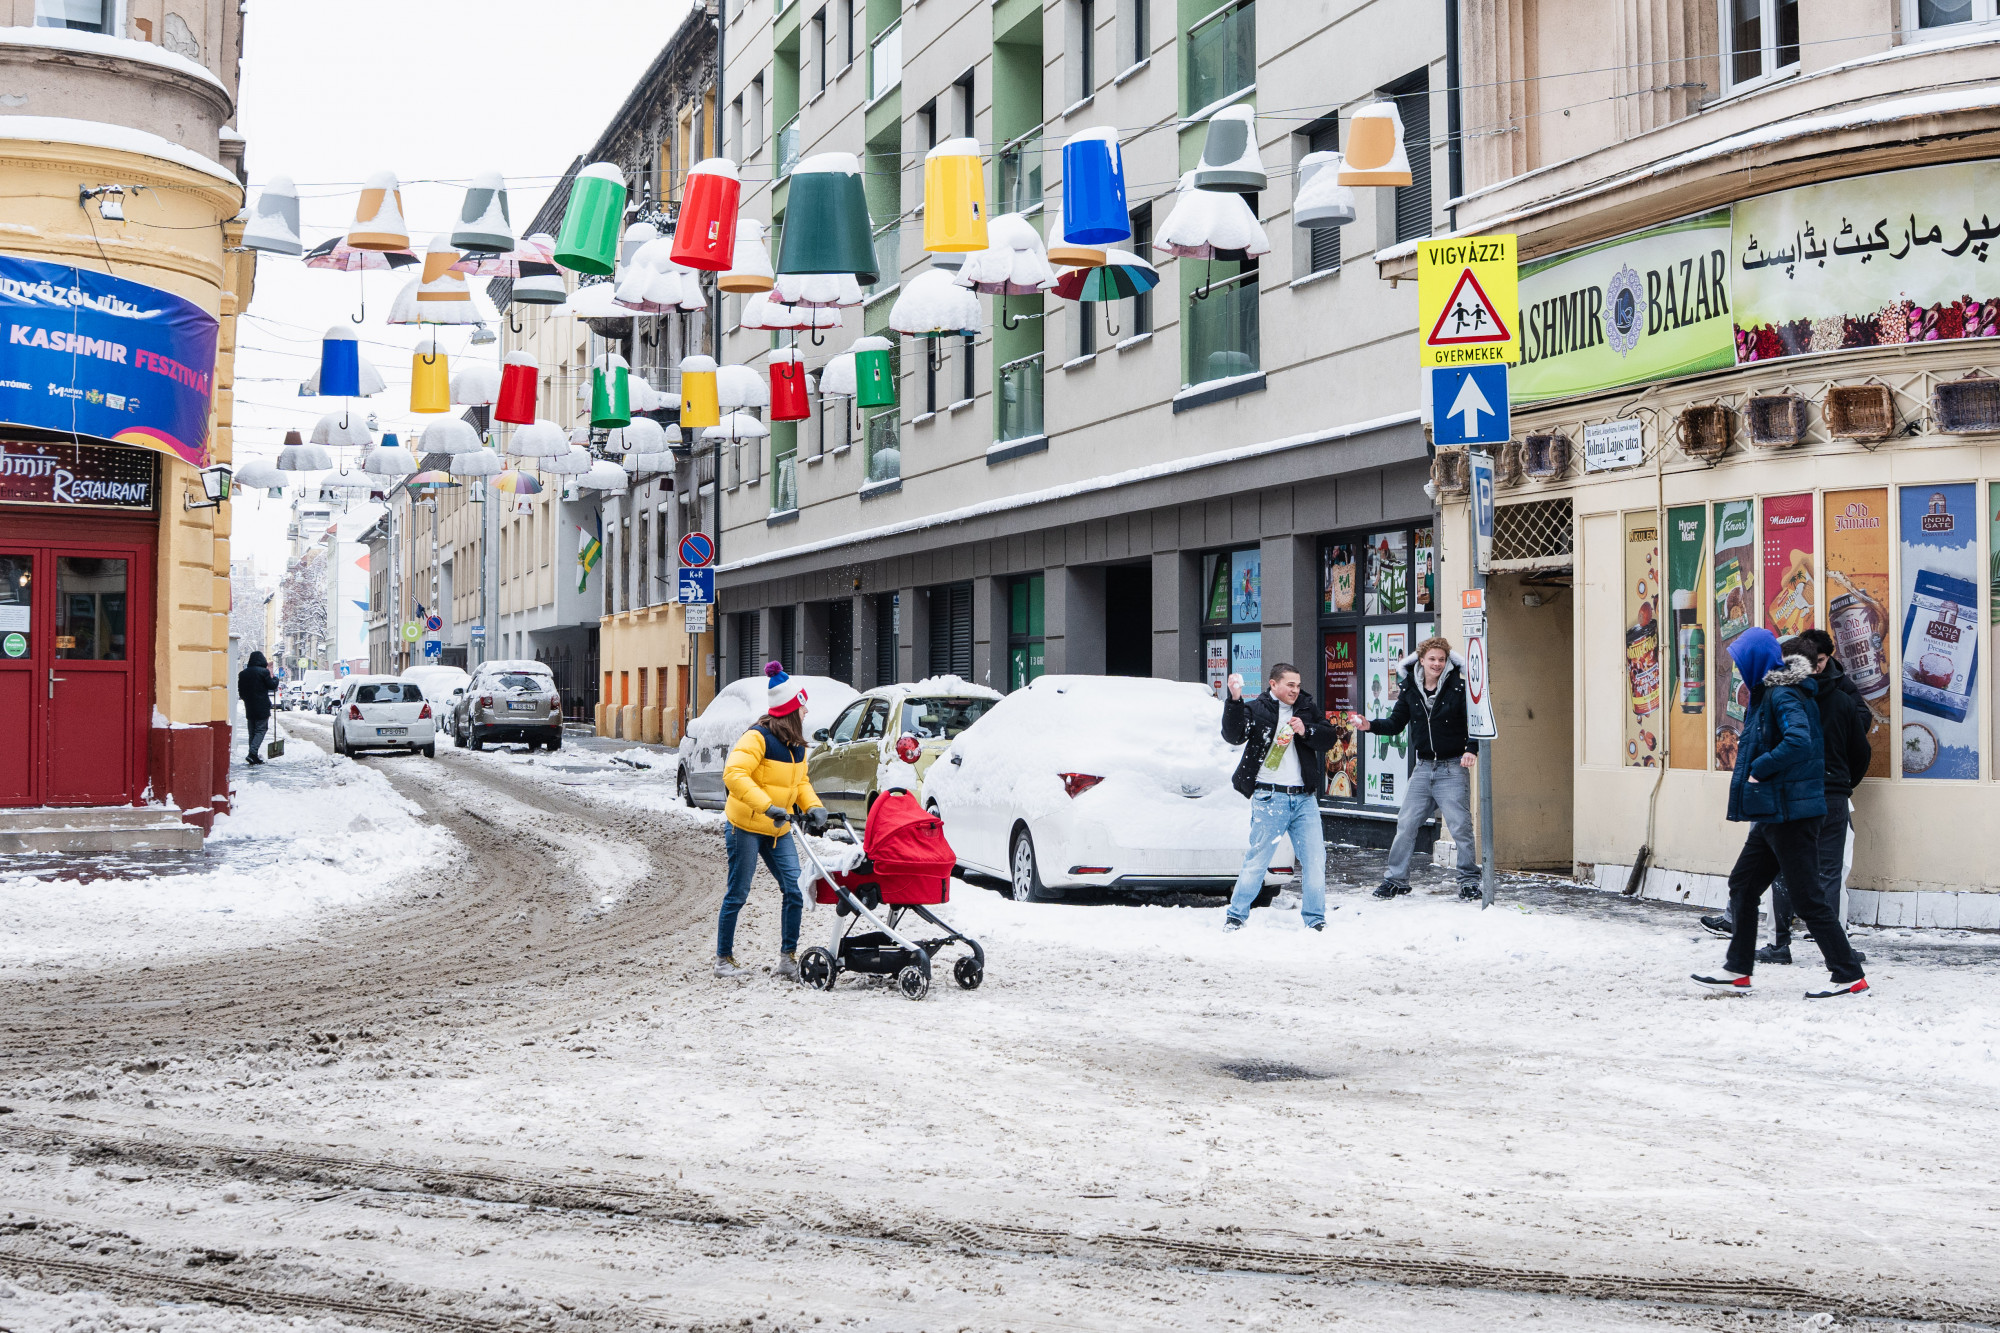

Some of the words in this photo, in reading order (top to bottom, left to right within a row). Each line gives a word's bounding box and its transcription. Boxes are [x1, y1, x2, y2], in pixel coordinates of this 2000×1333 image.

[1429, 241, 1505, 266] VIGYÁZZ!
[1508, 286, 1604, 369] ASHMIR
[1647, 249, 1729, 337] BAZAR
[10, 324, 128, 365] KASHMIR
[135, 348, 209, 397] FESZTIVÁL
[1435, 347, 1503, 362] GYERMEKEK
[1587, 437, 1606, 456] Tolnai
[1607, 436, 1624, 456] Lajos
[1625, 434, 1639, 450] utca
[1845, 503, 1868, 518] Old
[1679, 520, 1698, 532] Hyper
[1724, 520, 1746, 532] Knorr
[1770, 515, 1806, 526] Maliban
[1834, 516, 1880, 532] Jamaica
[1682, 531, 1695, 541] Malt
[689, 570, 704, 579] K+R
[1844, 618, 1860, 631] Old
[1930, 622, 1959, 636] INDIA
[1838, 625, 1870, 644] Jamaica
[1929, 629, 1957, 641] GATE
[1211, 648, 1222, 657] FREE
[1844, 639, 1870, 658] GINGER
[1208, 659, 1228, 668] DELIVERY
[1328, 660, 1341, 669] Marwa
[1342, 659, 1354, 668] Foods
[1470, 654, 1480, 683] 30
[1850, 654, 1870, 670] BEER
